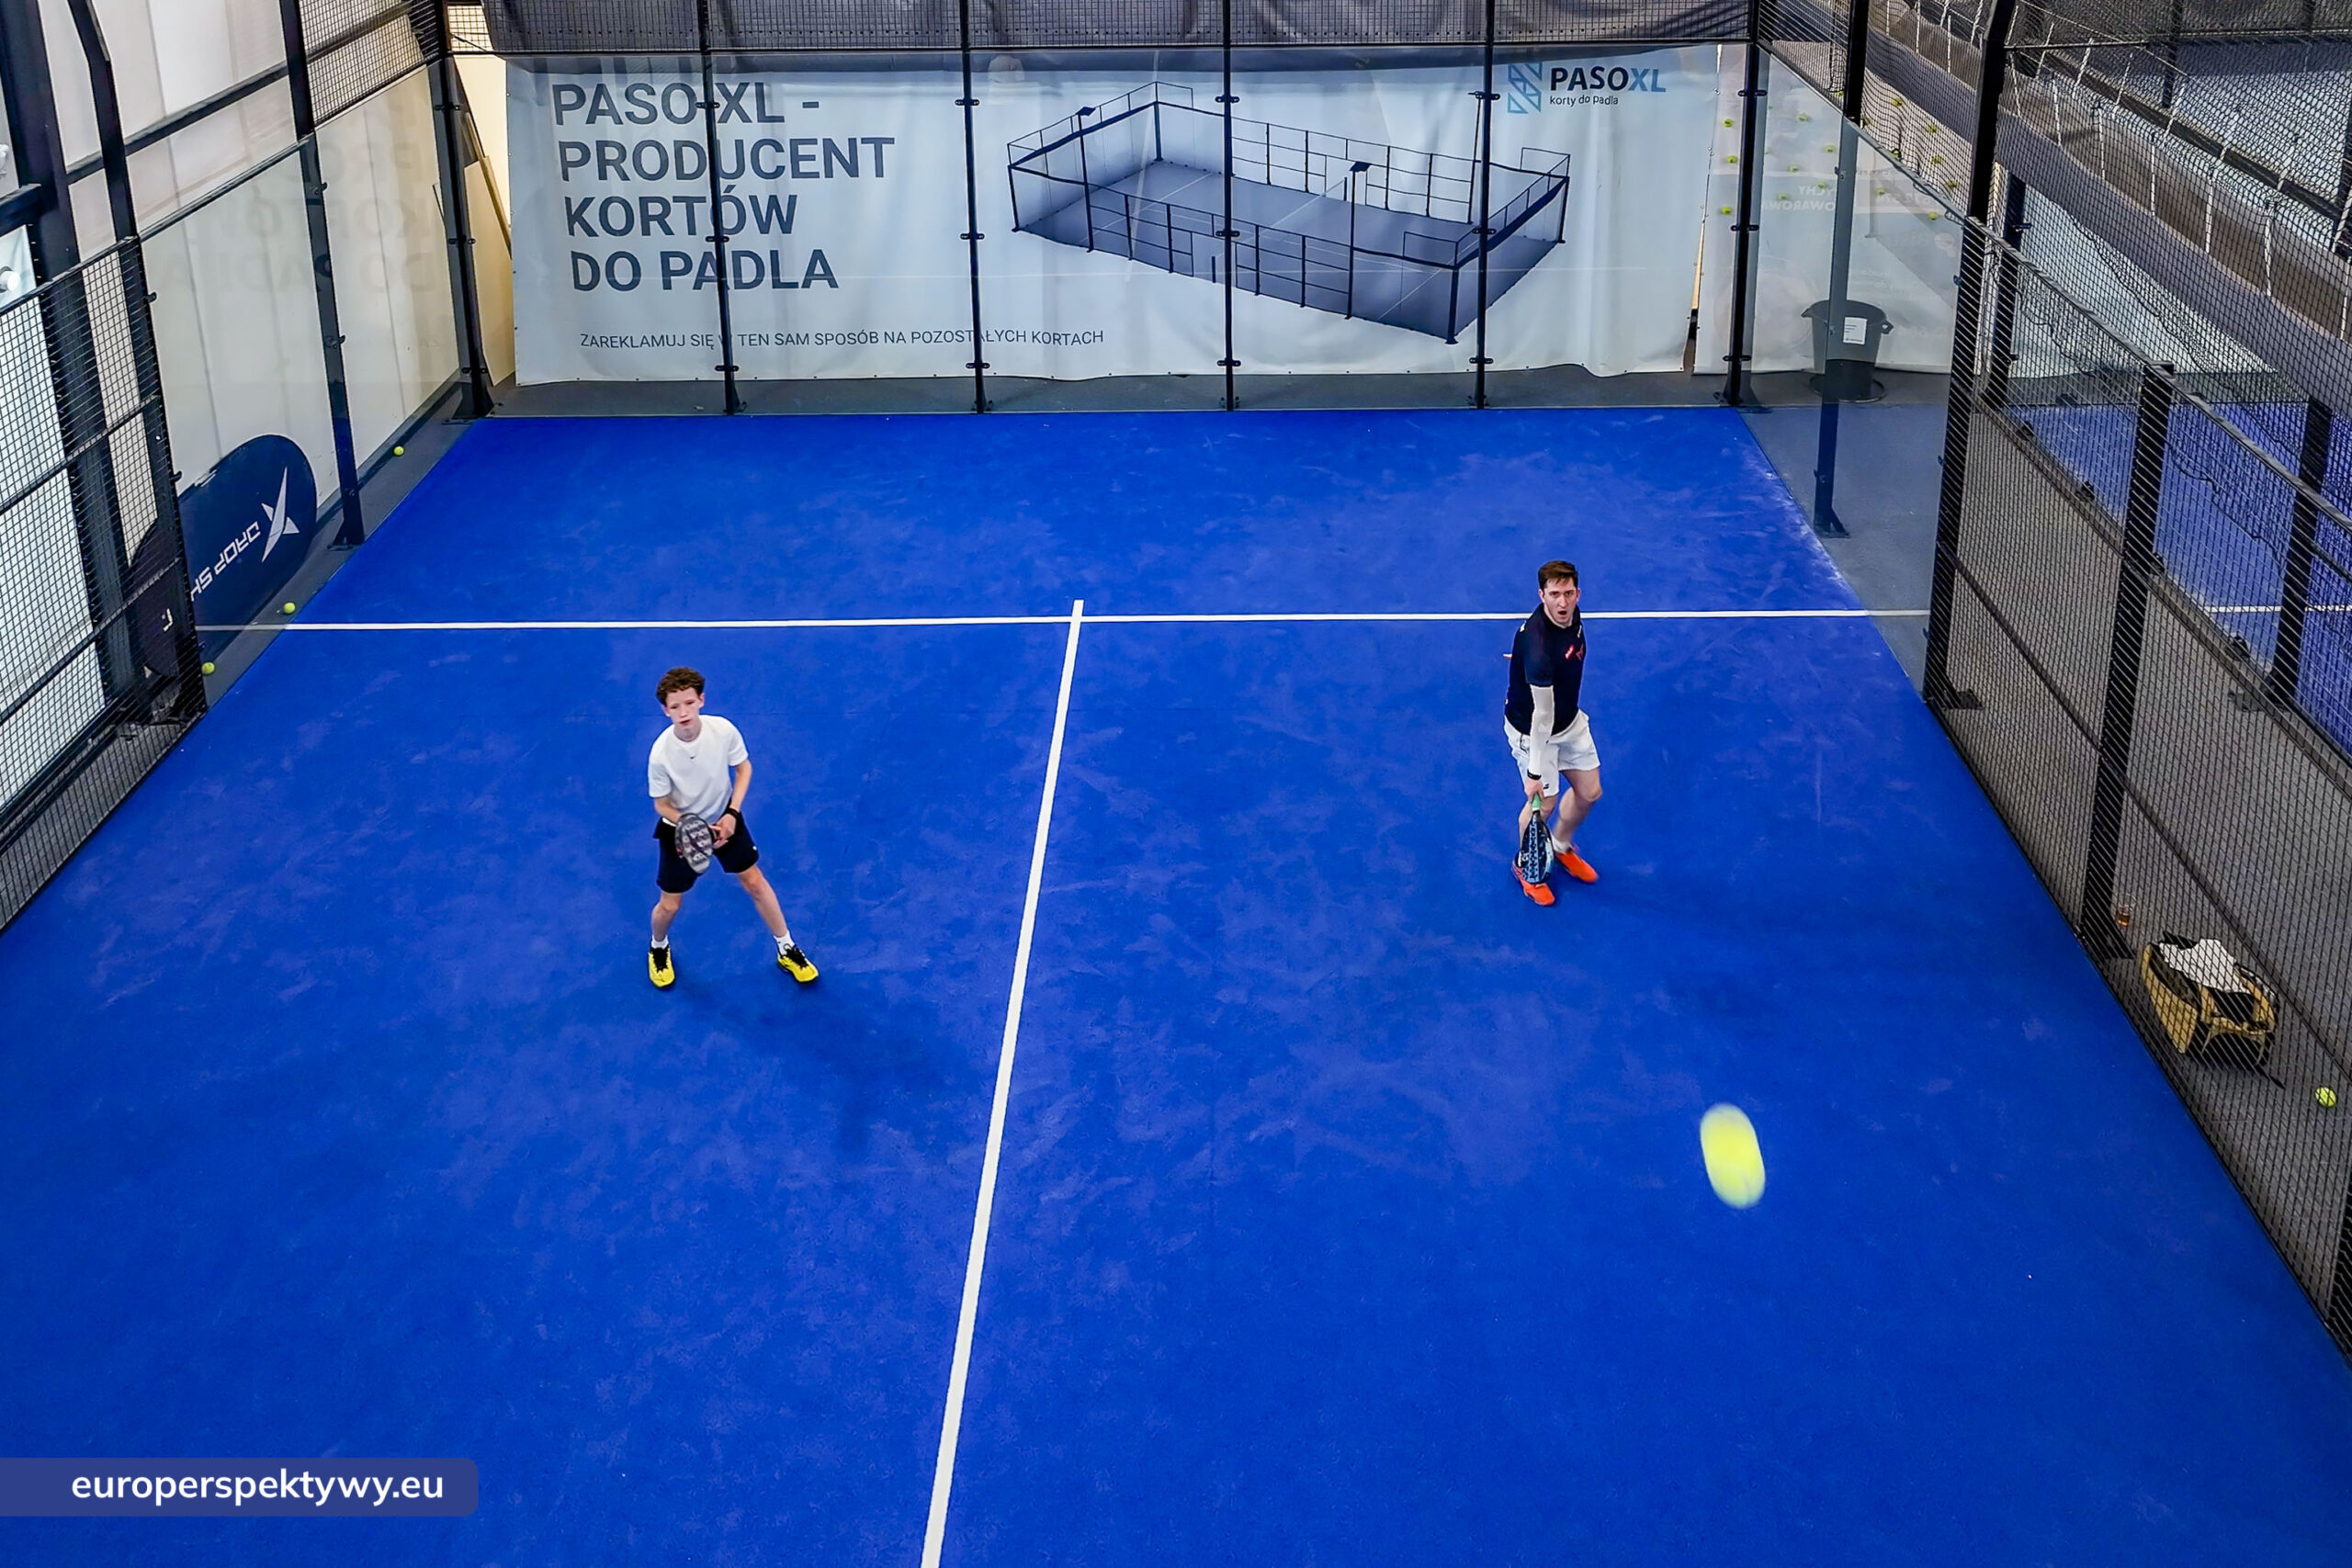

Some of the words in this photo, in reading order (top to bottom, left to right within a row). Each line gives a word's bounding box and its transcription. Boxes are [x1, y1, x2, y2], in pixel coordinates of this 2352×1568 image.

[552, 82, 697, 126] PASO
[715, 82, 785, 124] XL
[1549, 96, 1577, 107] korty
[1578, 94, 1590, 104] do
[1593, 95, 1619, 106] padla
[558, 137, 895, 181] PRODUCENT
[564, 184, 797, 237] KORTÓW
[571, 250, 641, 291] DO
[660, 249, 839, 290] PADLA
[580, 333, 686, 348] ZAREKLAMUJ
[691, 333, 714, 350] SIĘ
[738, 333, 770, 346] TEN
[775, 333, 809, 346] SAM
[814, 329, 878, 346] SPOSÓB
[884, 331, 907, 344] NA
[1032, 330, 1103, 346] KORTACH
